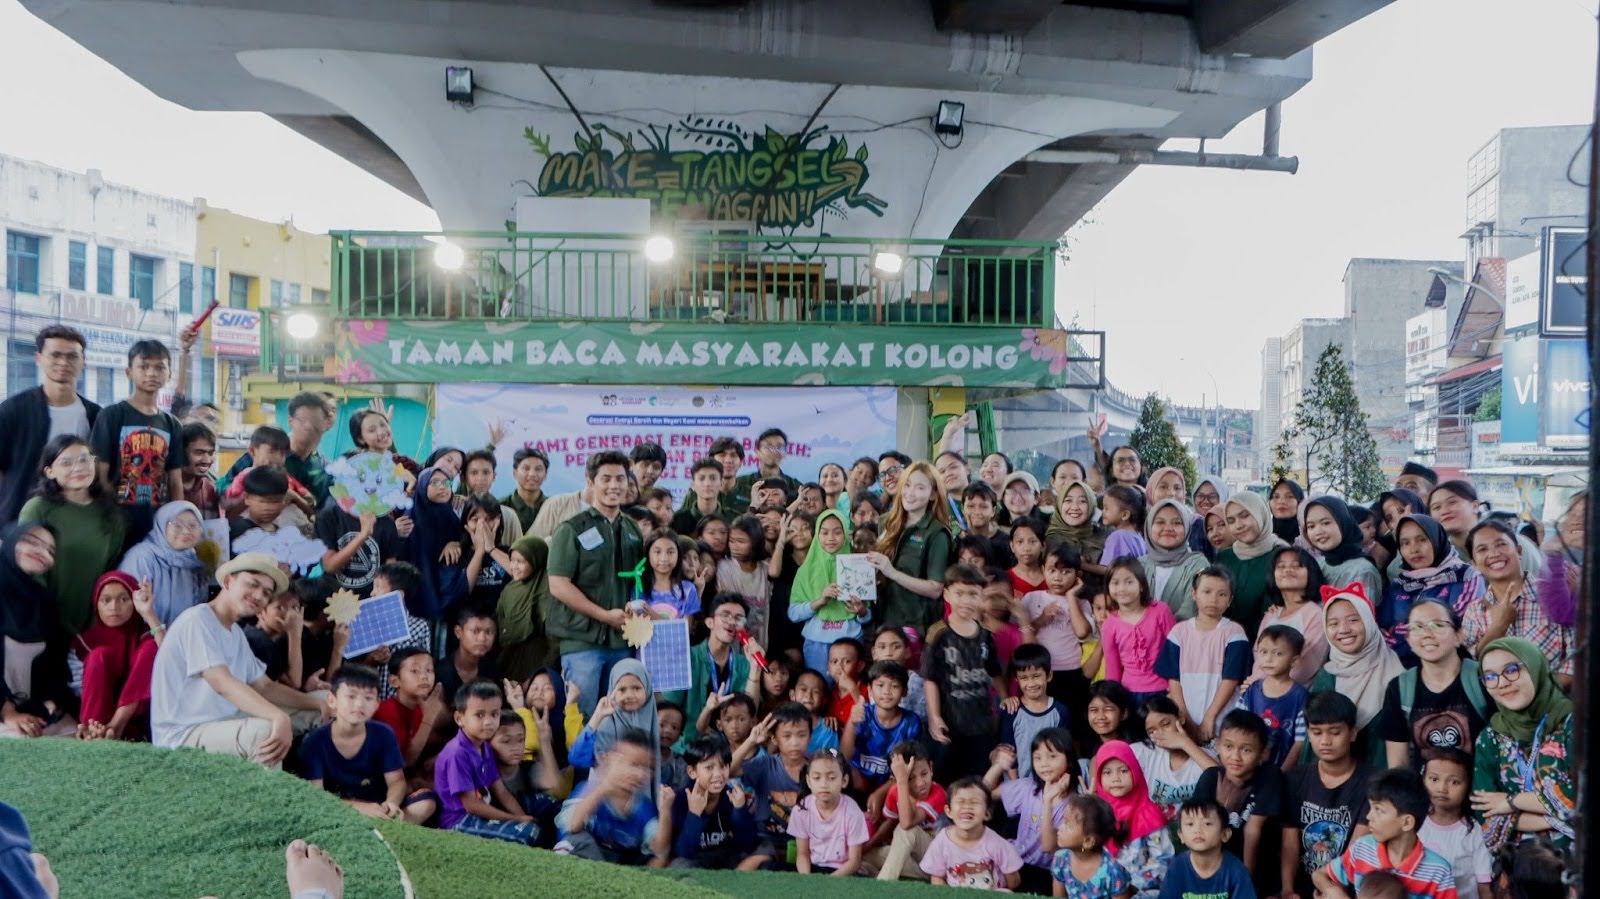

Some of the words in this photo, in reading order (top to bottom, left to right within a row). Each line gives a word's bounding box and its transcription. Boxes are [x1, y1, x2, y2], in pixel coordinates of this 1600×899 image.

[540, 151, 657, 193] MAKE
[671, 149, 843, 191] TANGSEL
[388, 338, 514, 366] TAMAN
[526, 338, 627, 366] BACA
[635, 339, 875, 368] MASYARAKAT
[884, 342, 1019, 370] KOLONG
[523, 437, 570, 452] KAMI
[575, 434, 664, 451] GENERASI
[671, 434, 722, 449] ENER
